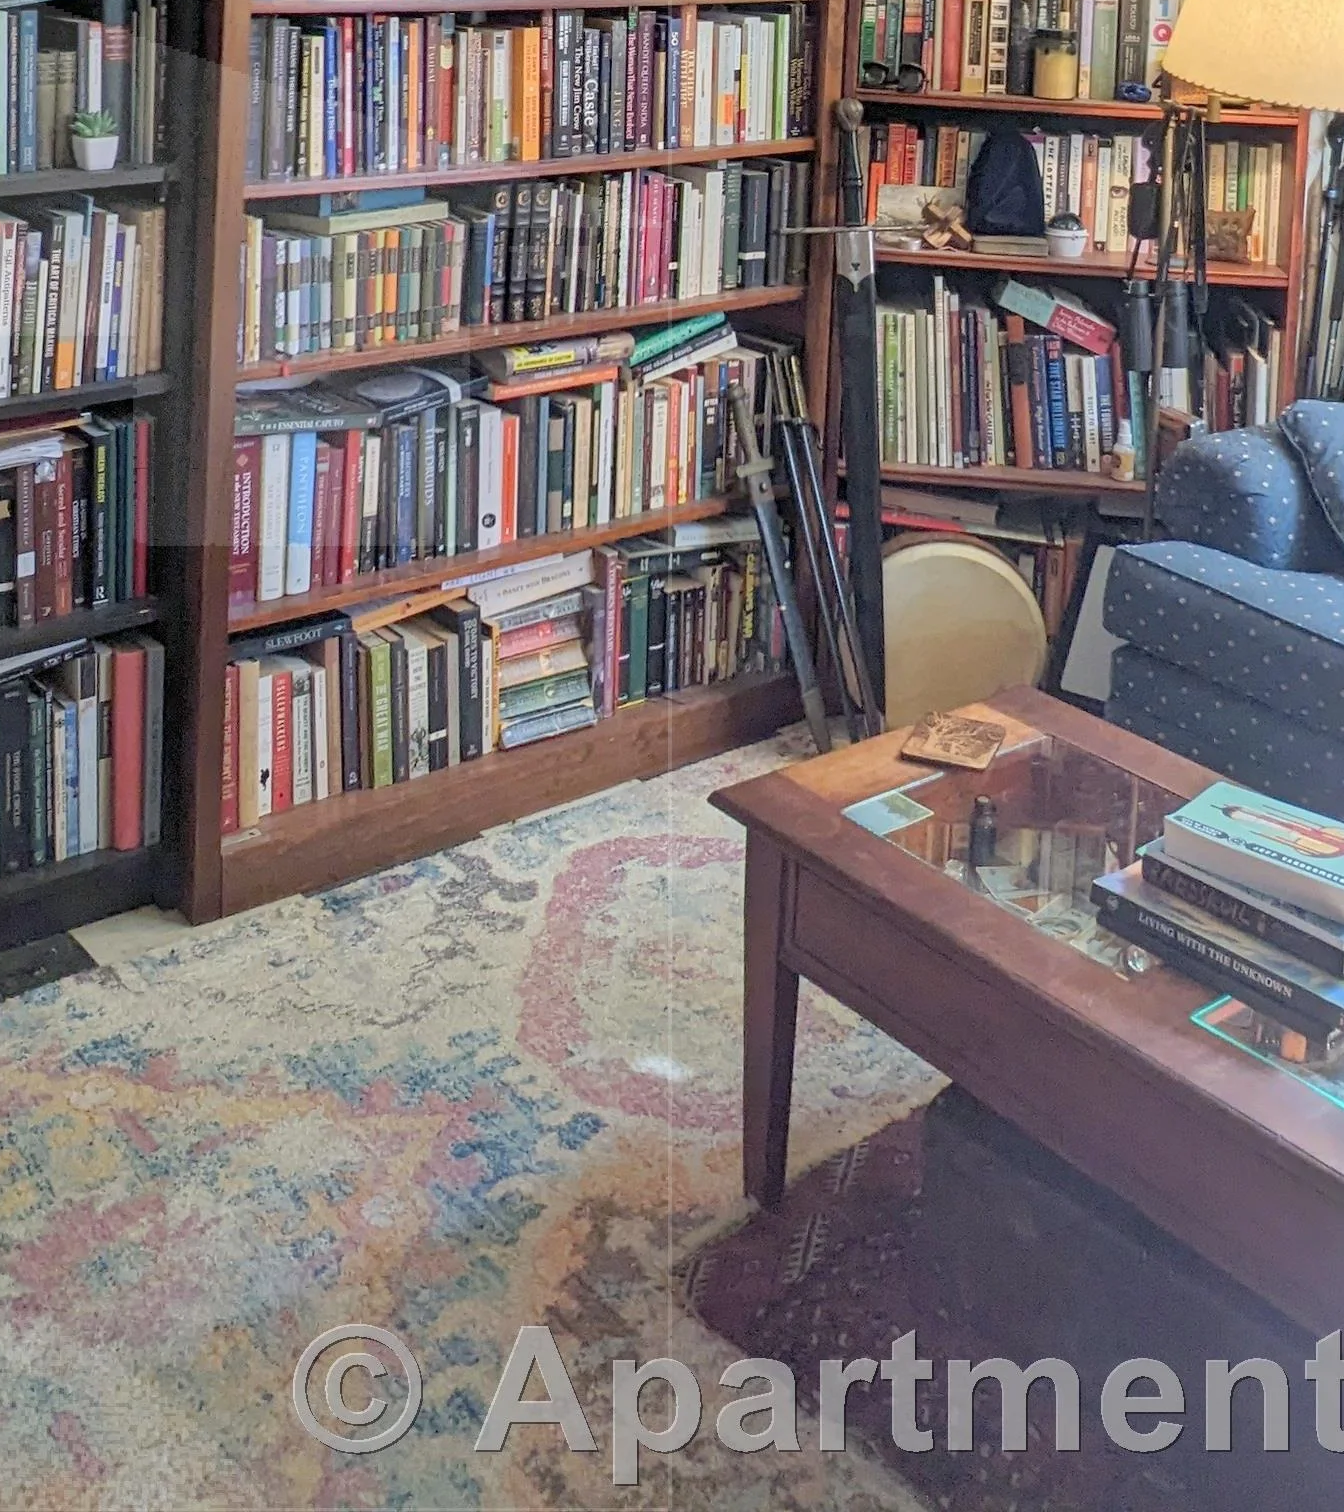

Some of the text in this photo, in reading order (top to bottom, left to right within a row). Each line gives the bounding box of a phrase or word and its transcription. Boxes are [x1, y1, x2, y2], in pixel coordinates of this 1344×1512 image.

[573, 47, 584, 131] The New Jim Crow
[583, 78, 598, 126] Caste
[612, 90, 623, 127] JUNG
[626, 32, 636, 139] The Woman That Never Evolved
[640, 31, 650, 128] BANDIT QUEEN INDIA
[687, 48, 696, 101] TOUCHED
[1043, 139, 1055, 210] THE LOTTERY
[2, 248, 14, 327] SQL Antipatterns
[44, 248, 62, 358] THE ART OF CRITICAL MAKING
[297, 455, 311, 534] PANTHEON
[424, 427, 435, 506] THE DRUIDS
[57, 483, 67, 560] Sacred and Secular
[232, 511, 241, 555] TESTAMENT
[240, 471, 253, 554] INTRODUCTION
[265, 626, 324, 650] SLEWFOOT
[470, 663, 479, 700] VICTORY
[375, 698, 388, 752] GREAT WAR
[1138, 910, 1294, 999] LIVING WITH THE UNKNOWN
